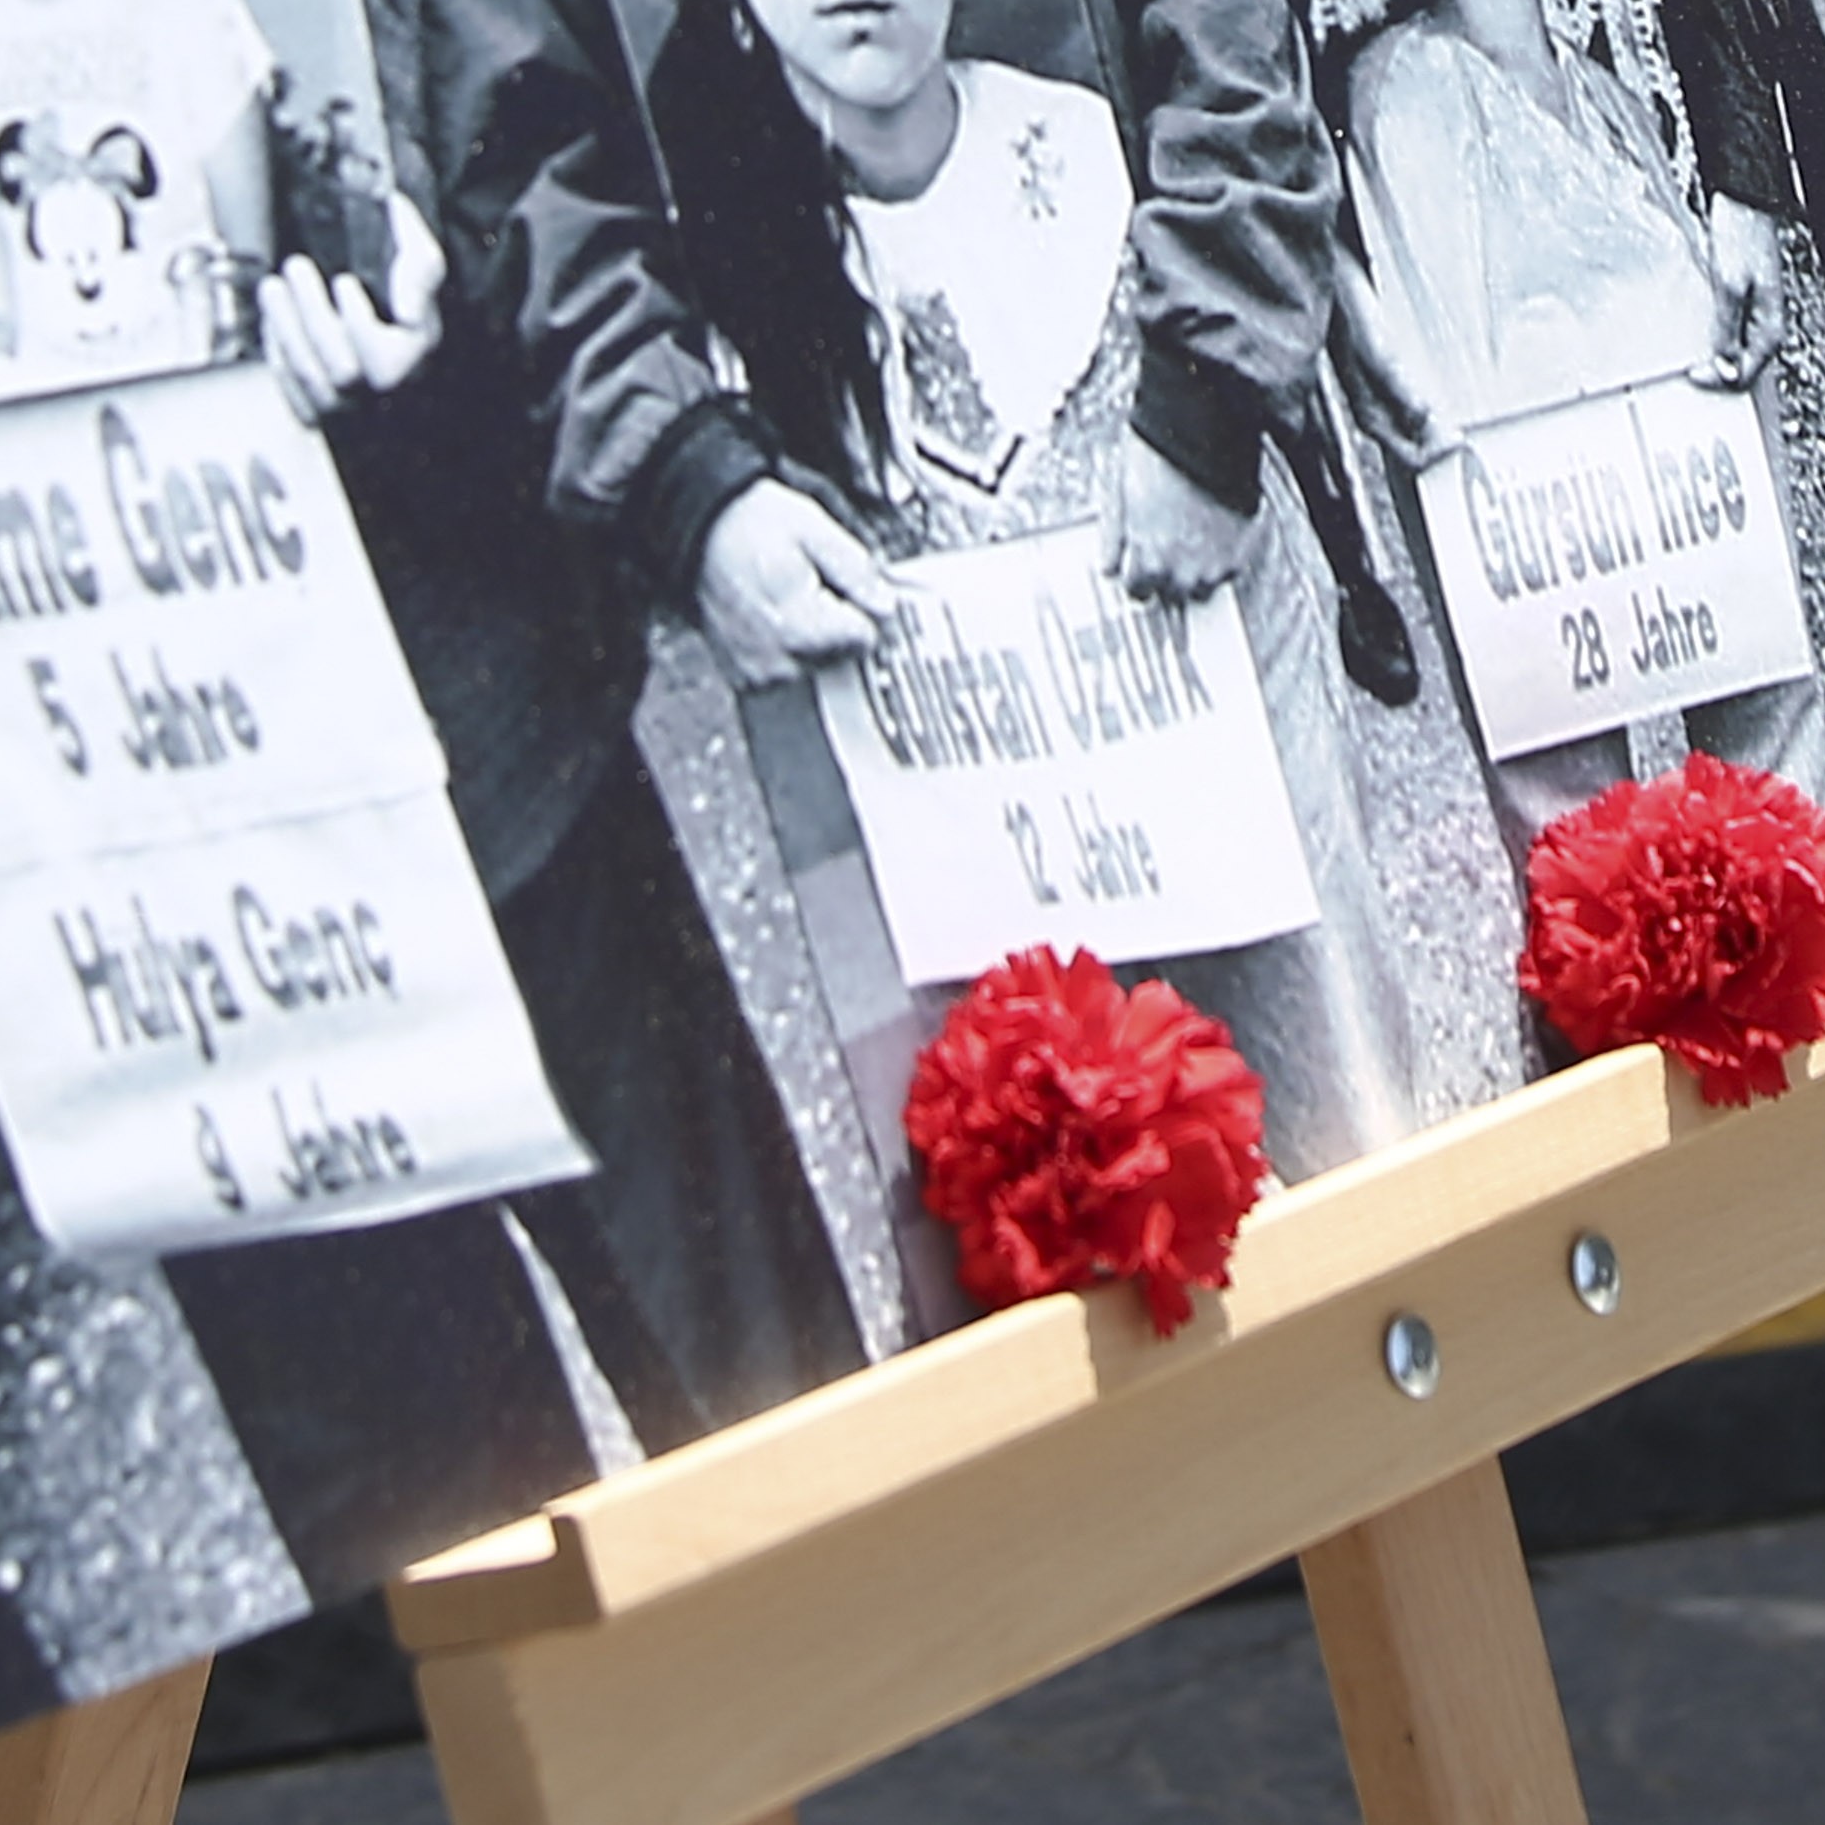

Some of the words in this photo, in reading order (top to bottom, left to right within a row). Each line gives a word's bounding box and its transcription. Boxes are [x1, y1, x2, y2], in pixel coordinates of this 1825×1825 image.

[1561, 606, 1612, 692] 28
[1630, 584, 1720, 676] Jahre
[25, 657, 87, 776] 5
[110, 644, 260, 774] Jahre
[1004, 798, 1062, 906] 12
[1064, 790, 1163, 903] Jahre
[194, 1104, 247, 1214] 9
[271, 1078, 417, 1201] Jahre
